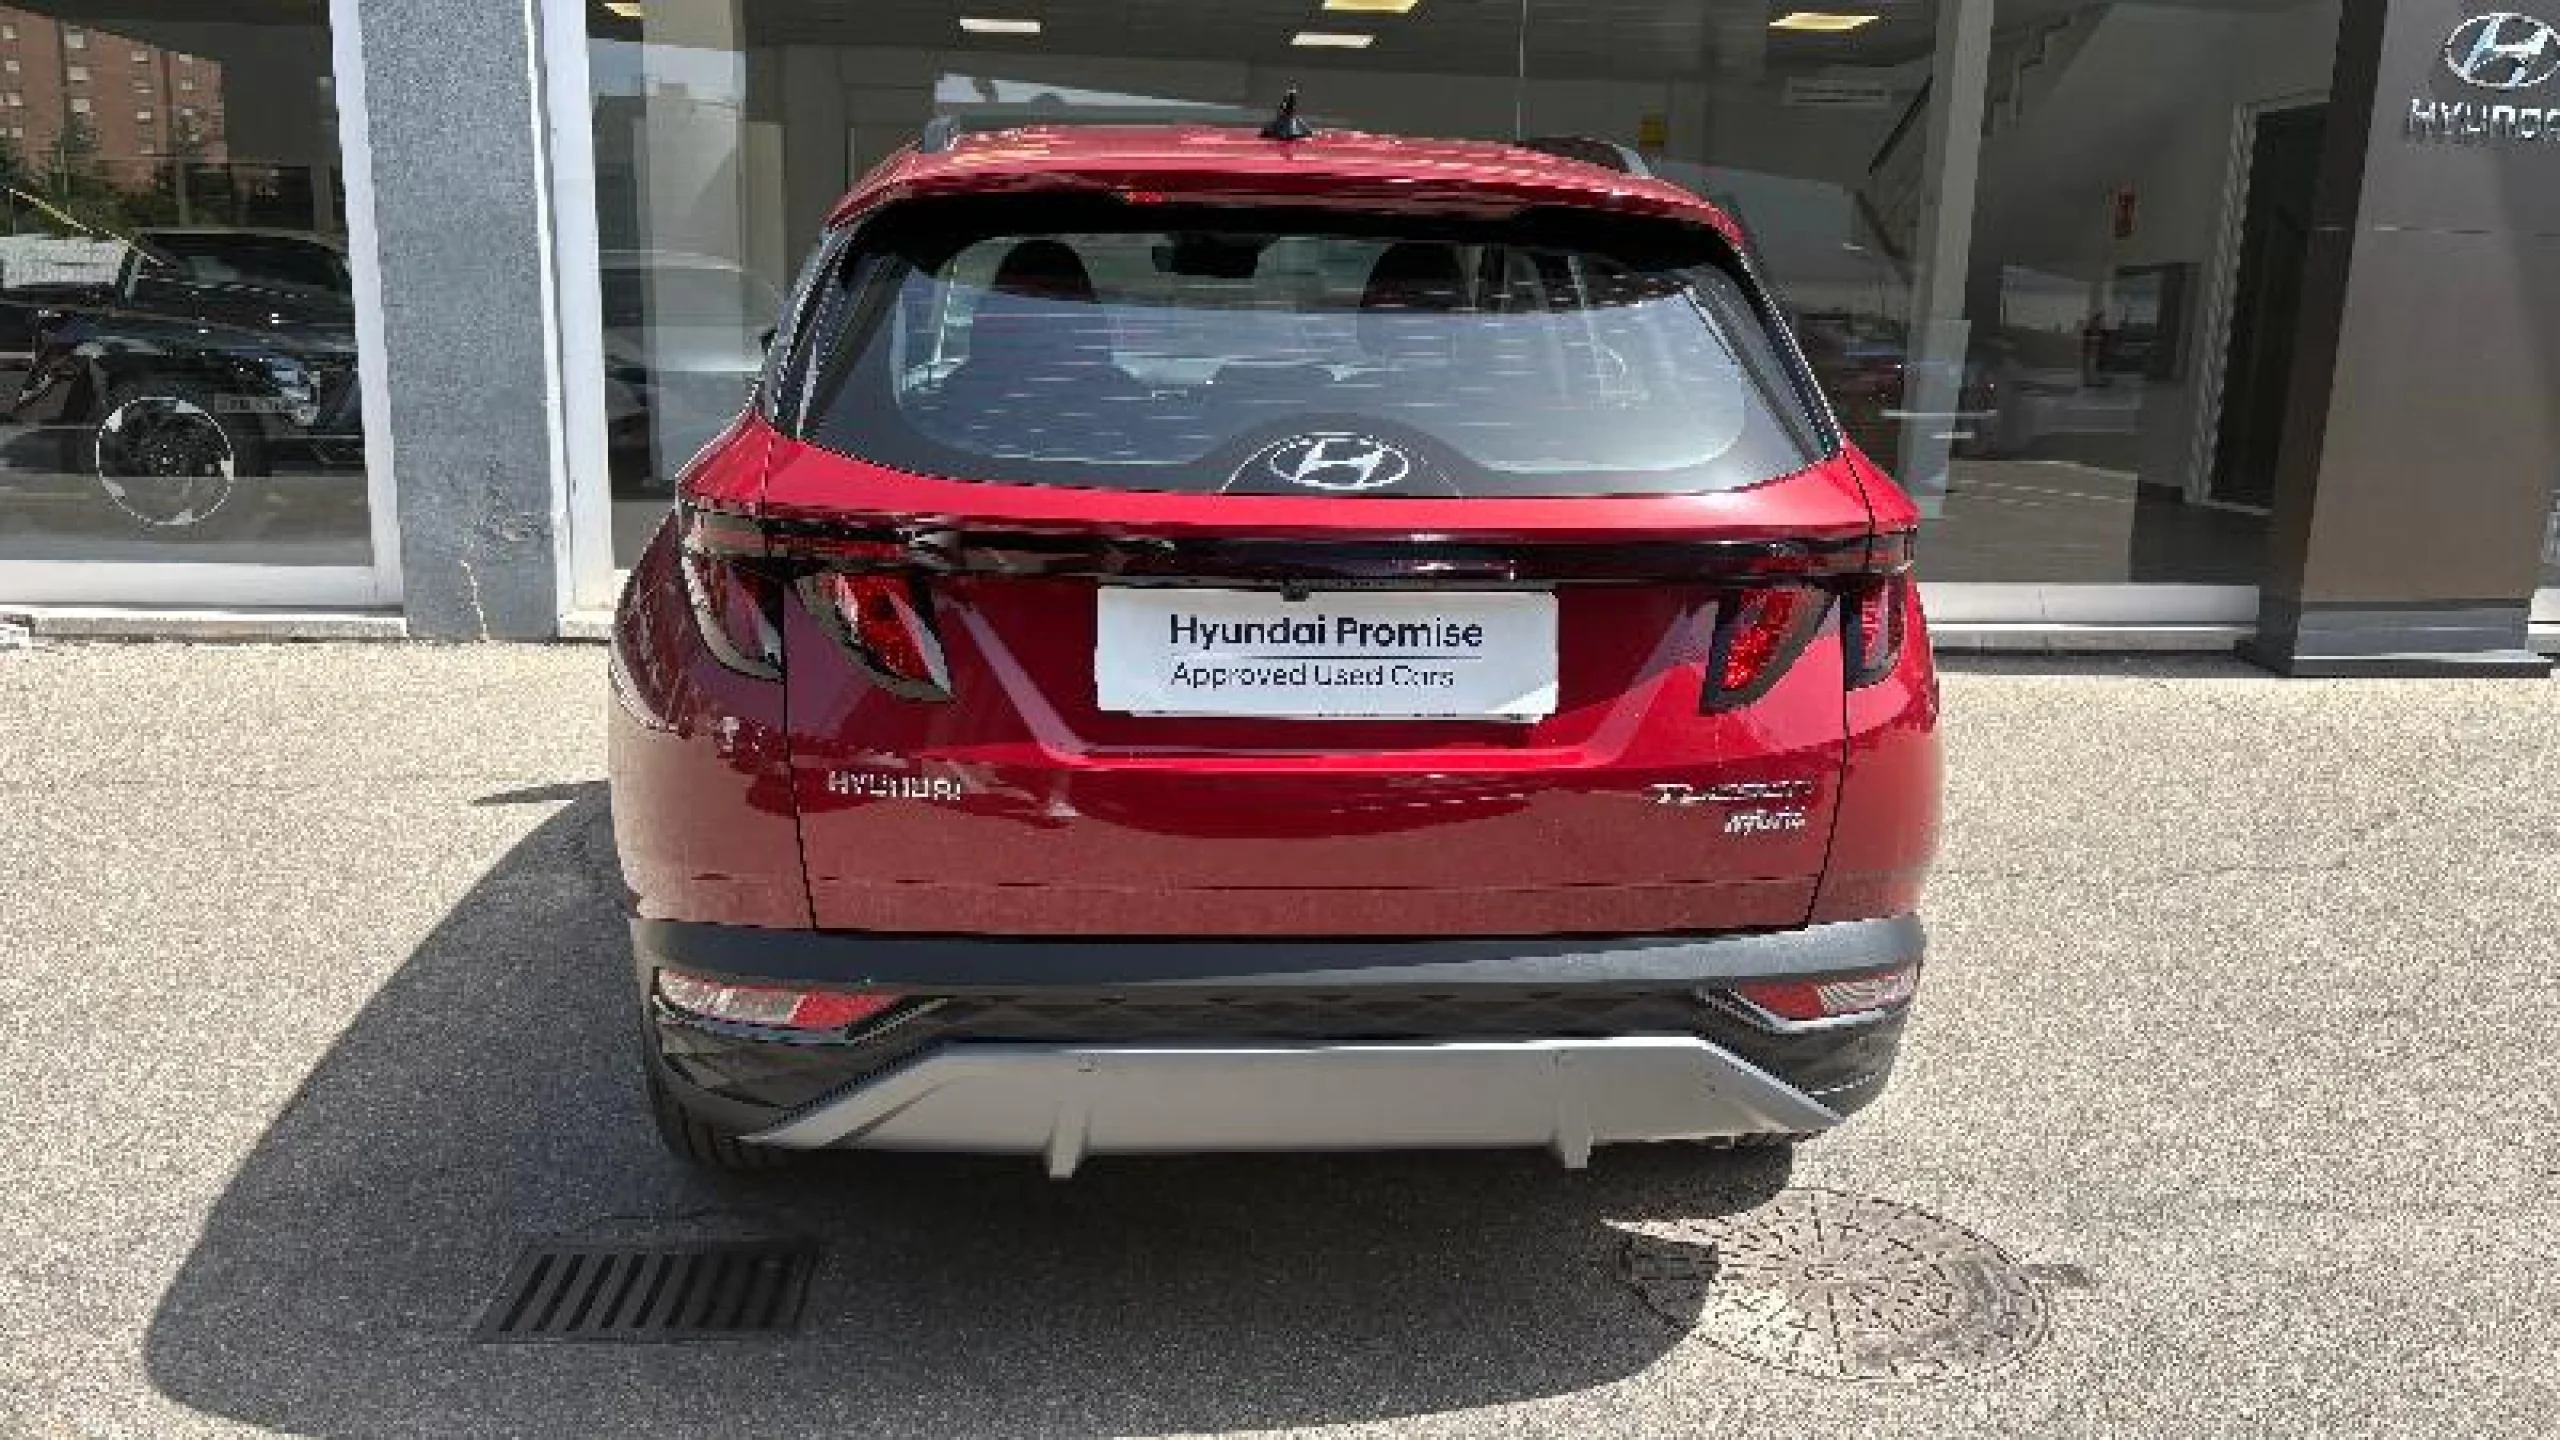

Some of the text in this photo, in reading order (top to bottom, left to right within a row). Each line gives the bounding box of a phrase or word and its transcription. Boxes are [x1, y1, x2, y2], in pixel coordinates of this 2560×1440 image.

[1170, 612, 1483, 650] Hyundai Promise
[1171, 662, 1454, 689] Approved Used Cars
[829, 771, 960, 800] HYUNDAI
